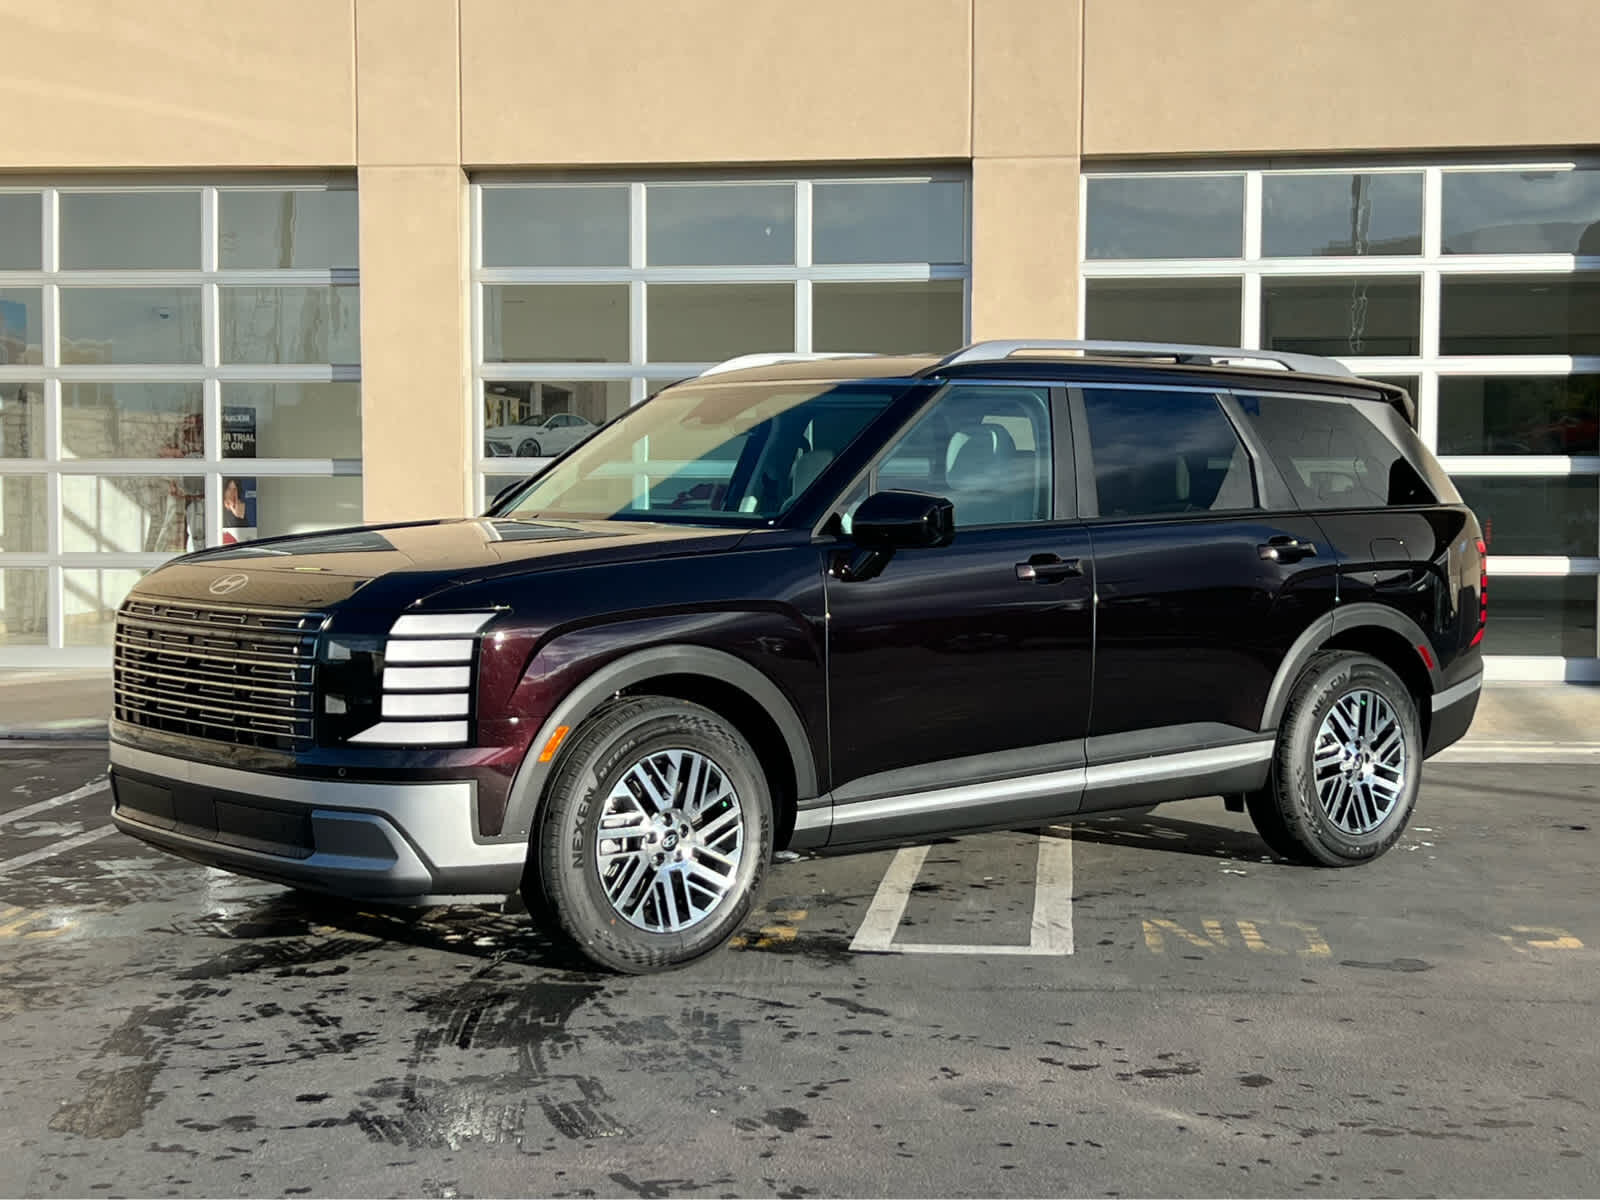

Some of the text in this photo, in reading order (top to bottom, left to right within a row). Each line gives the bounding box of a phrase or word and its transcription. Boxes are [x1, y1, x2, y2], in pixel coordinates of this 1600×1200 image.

[232, 432, 255, 442] TRIAL
[231, 441, 243, 451] ON
[572, 786, 596, 869] NEXEN
